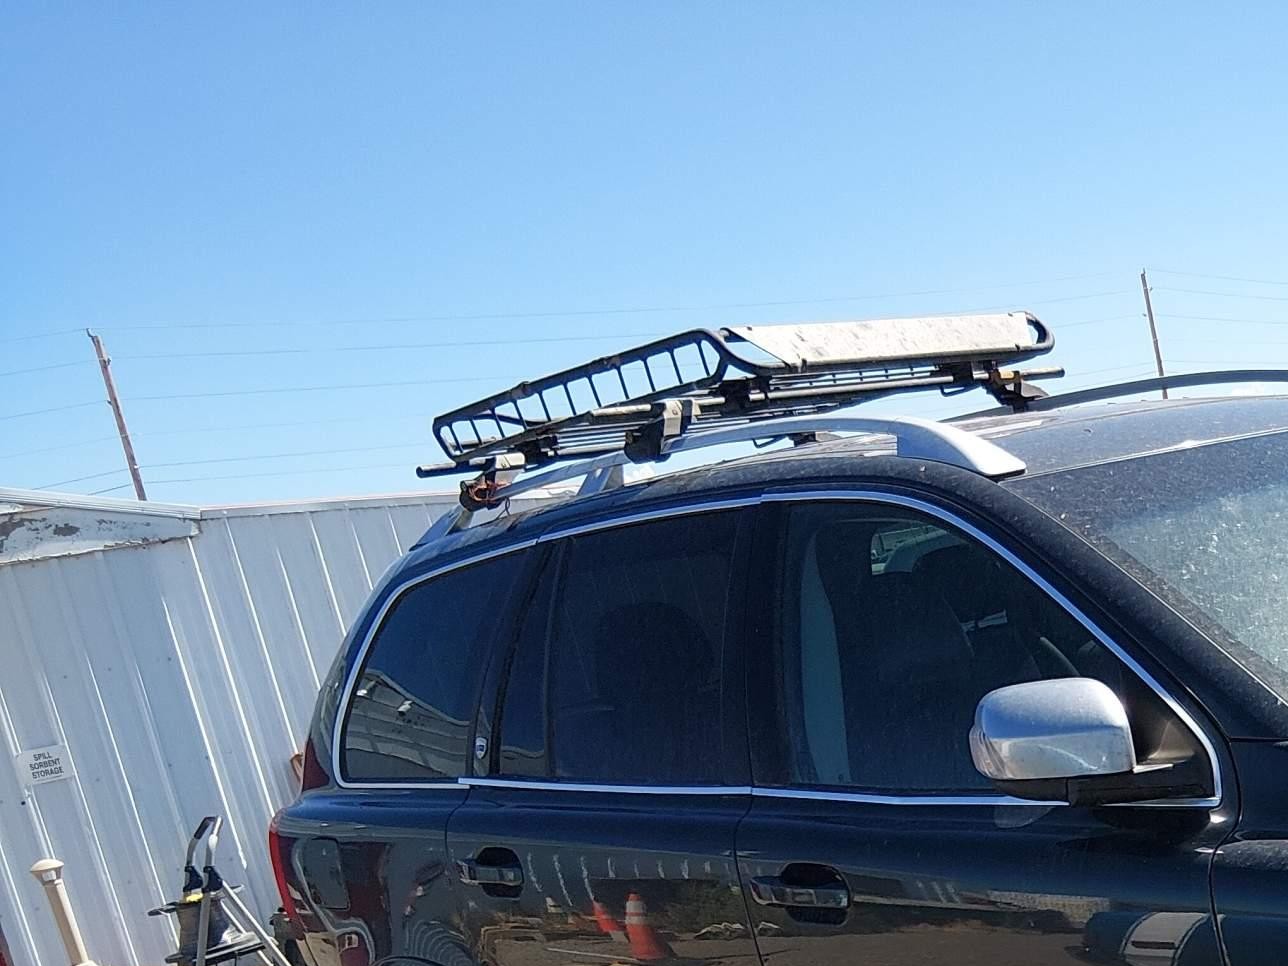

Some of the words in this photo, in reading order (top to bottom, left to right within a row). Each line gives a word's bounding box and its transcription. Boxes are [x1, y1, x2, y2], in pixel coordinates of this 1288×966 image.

[33, 752, 52, 761] SPILL
[29, 758, 61, 771] SORBENT
[32, 766, 64, 779] STORAGE
